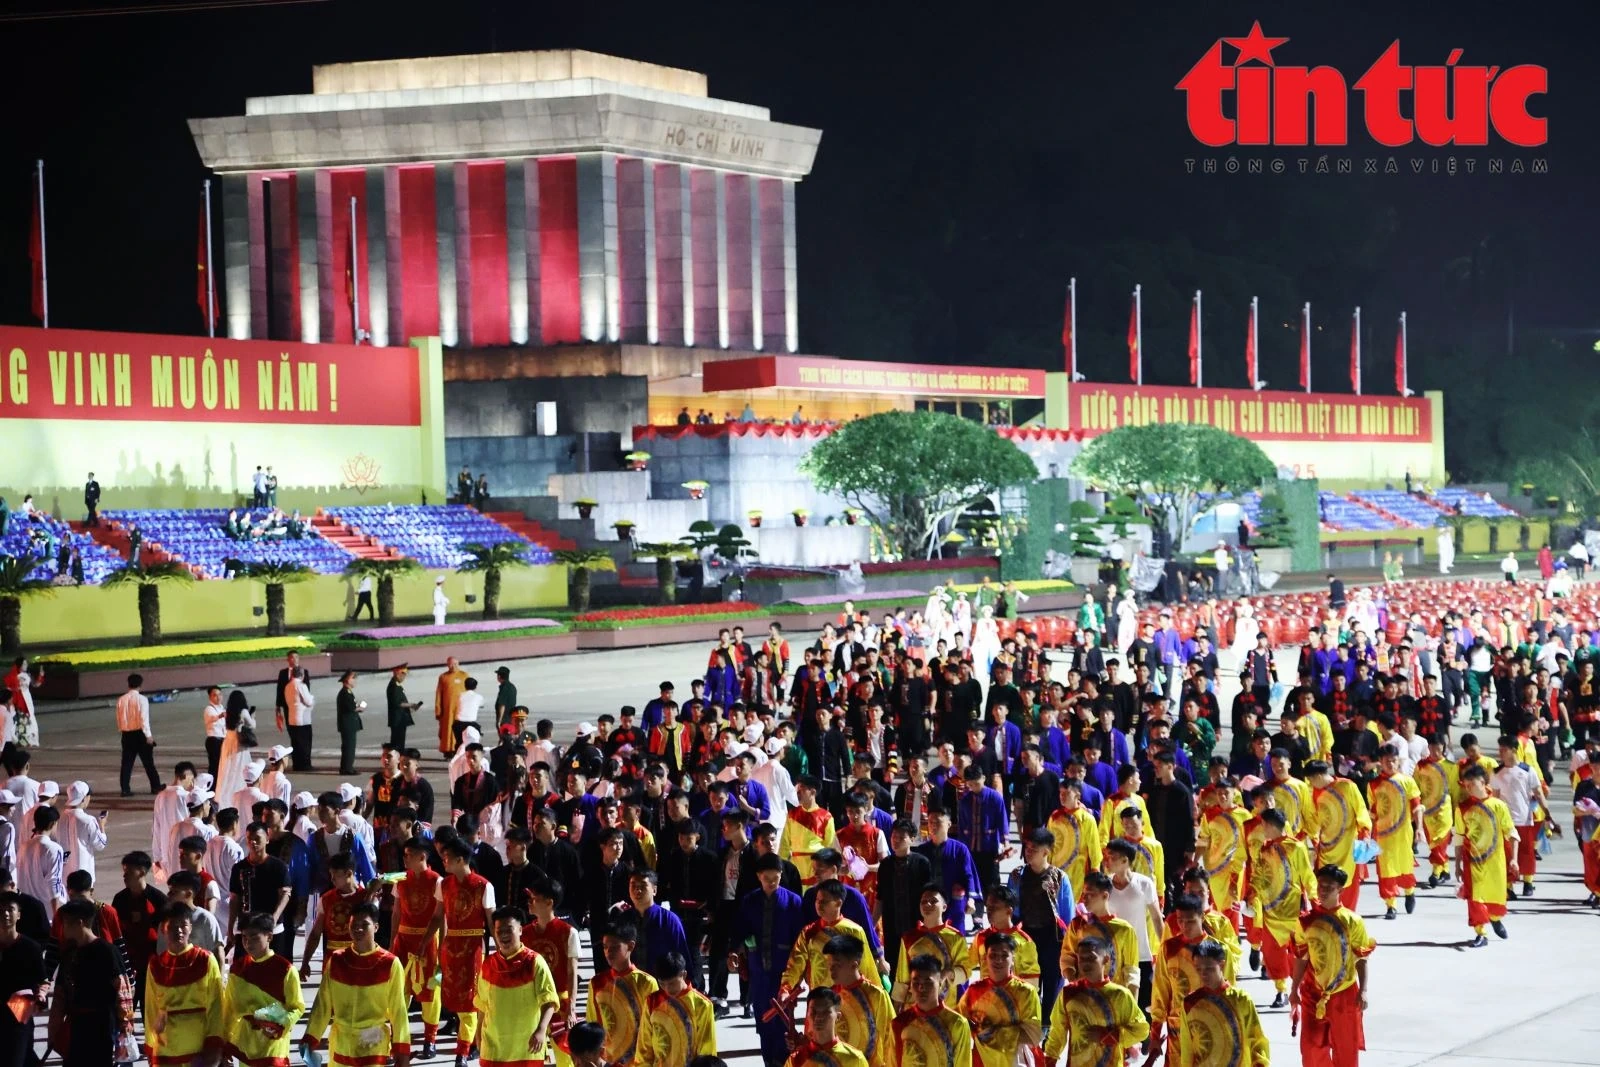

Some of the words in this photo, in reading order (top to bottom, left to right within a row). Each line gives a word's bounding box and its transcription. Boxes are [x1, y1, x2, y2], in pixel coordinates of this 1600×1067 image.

[48, 350, 132, 407] VINH
[151, 348, 240, 410] MUÔN
[1080, 389, 1118, 430] NƯỚC
[1240, 394, 1264, 433] CHỦ
[1268, 397, 1303, 434] NGHĨA
[1307, 398, 1331, 440] VIỆT
[1335, 404, 1357, 434] NAM
[1361, 401, 1389, 435] MUÔN
